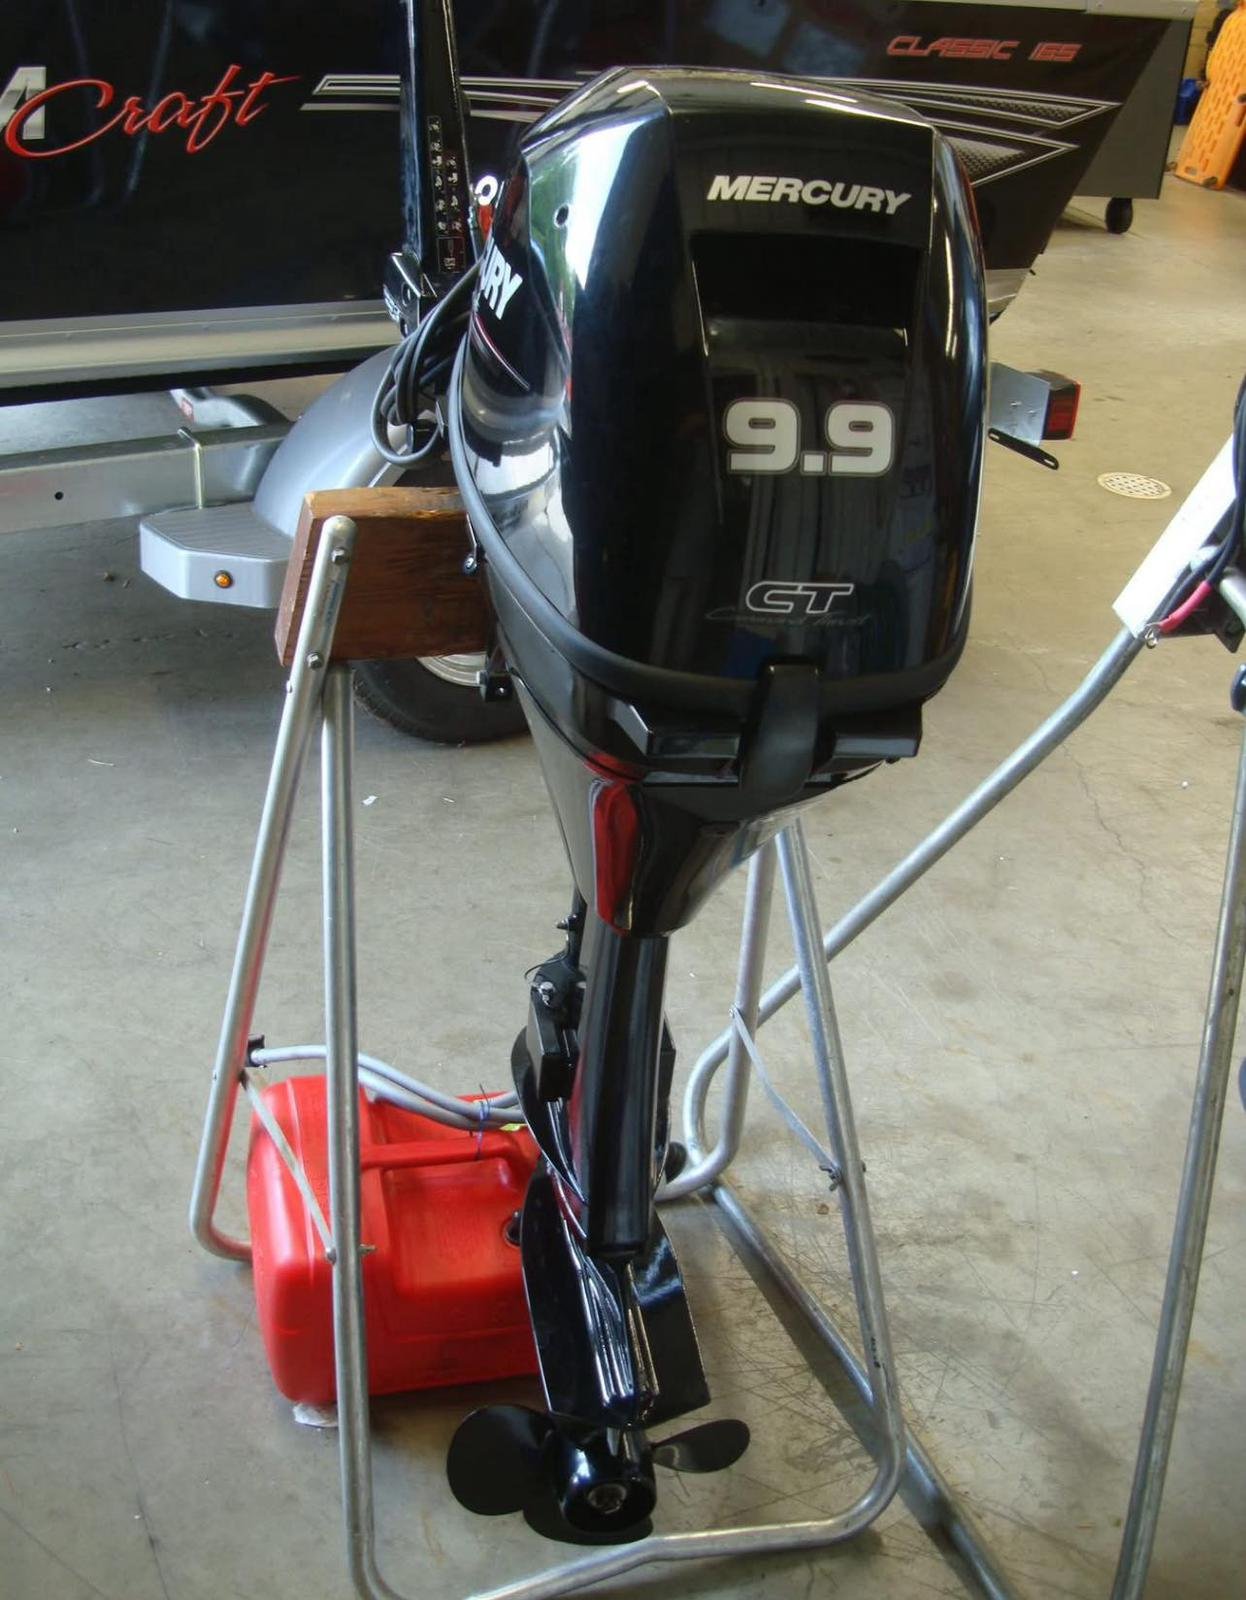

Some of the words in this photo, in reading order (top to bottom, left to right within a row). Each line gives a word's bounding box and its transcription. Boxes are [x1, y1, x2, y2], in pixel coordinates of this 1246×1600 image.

[887, 35, 1020, 60] CLASSIC
[1028, 42, 1082, 62] 165
[4, 64, 299, 157] Craft
[707, 175, 911, 214] MERCURY
[723, 397, 895, 476] 9.9
